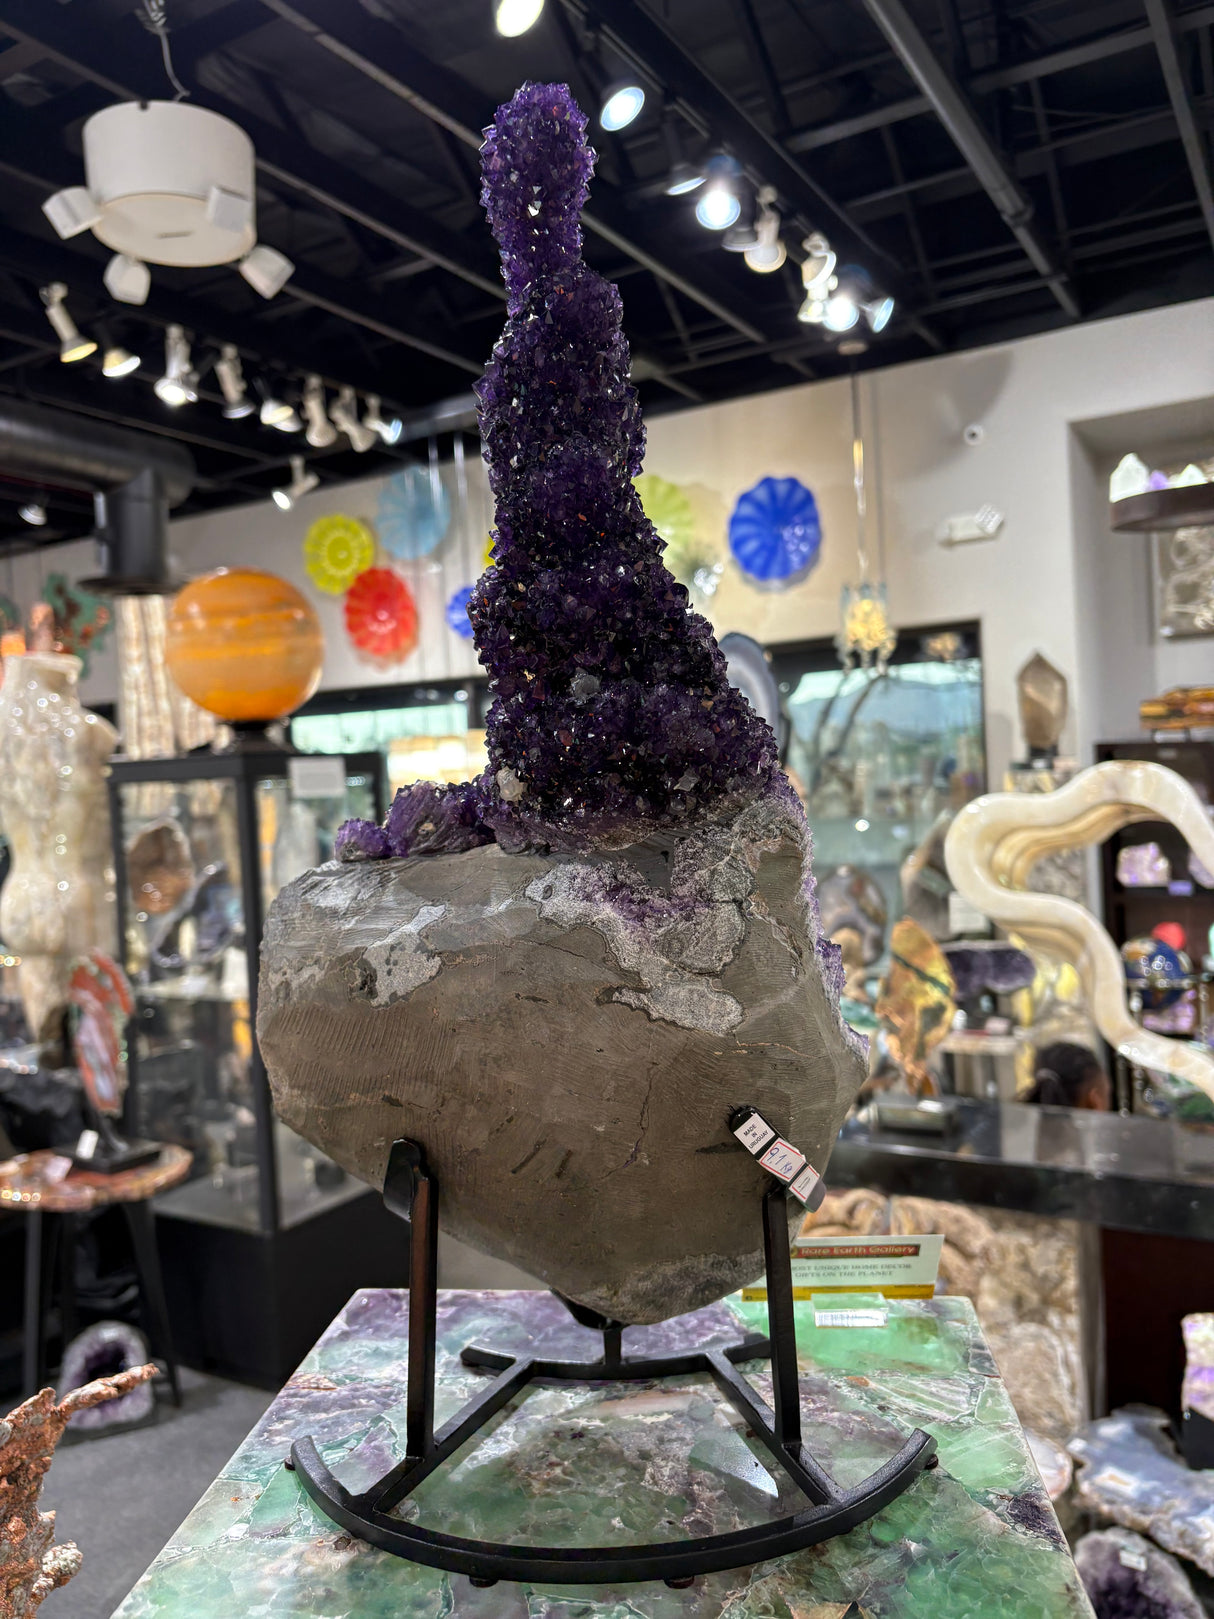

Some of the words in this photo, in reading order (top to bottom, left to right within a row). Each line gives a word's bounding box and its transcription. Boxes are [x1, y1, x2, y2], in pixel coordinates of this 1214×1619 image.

[743, 1123, 757, 1136] MADE
[748, 1130, 769, 1149] URUGUAY
[801, 1247, 830, 1256] Rare
[834, 1246, 867, 1255] Earth
[869, 1244, 915, 1255] Gallery
